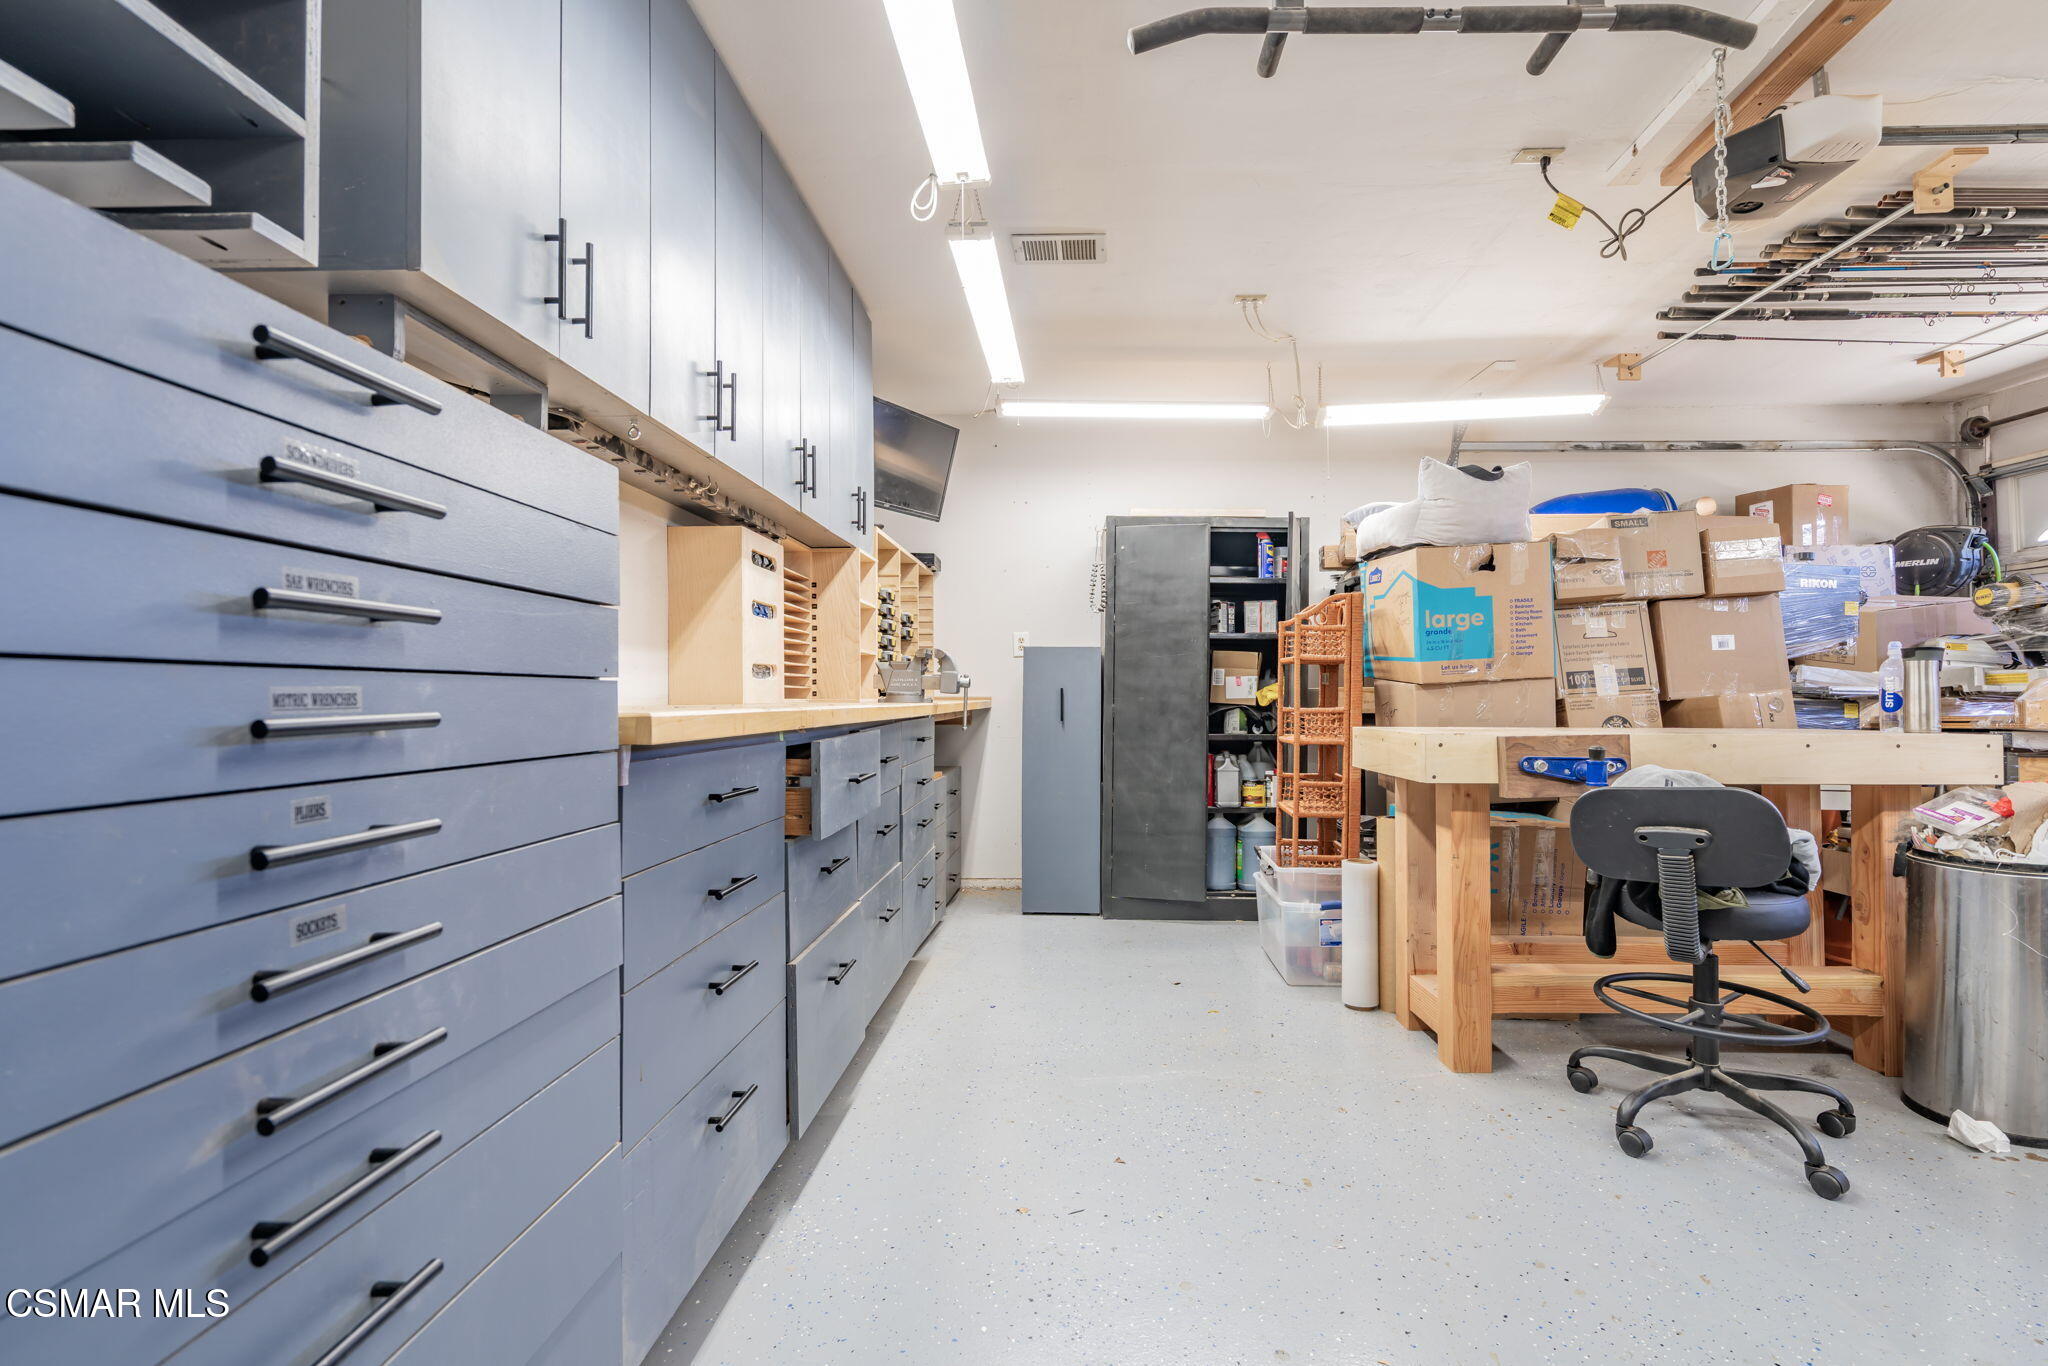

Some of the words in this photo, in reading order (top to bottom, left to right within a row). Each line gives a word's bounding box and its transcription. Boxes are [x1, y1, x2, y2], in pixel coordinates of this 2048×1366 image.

[1615, 519, 1645, 528] SMALL
[1895, 558, 1940, 568] MERLIN
[306, 576, 354, 596] WRENCHES
[1800, 578, 1838, 589] RIKON
[1425, 610, 1485, 631] large
[1425, 627, 1453, 637] grande
[272, 693, 308, 708] METRIC
[311, 692, 358, 707] WRENCHES
[294, 802, 327, 822] PLIERS
[295, 912, 338, 939] SOCKETS
